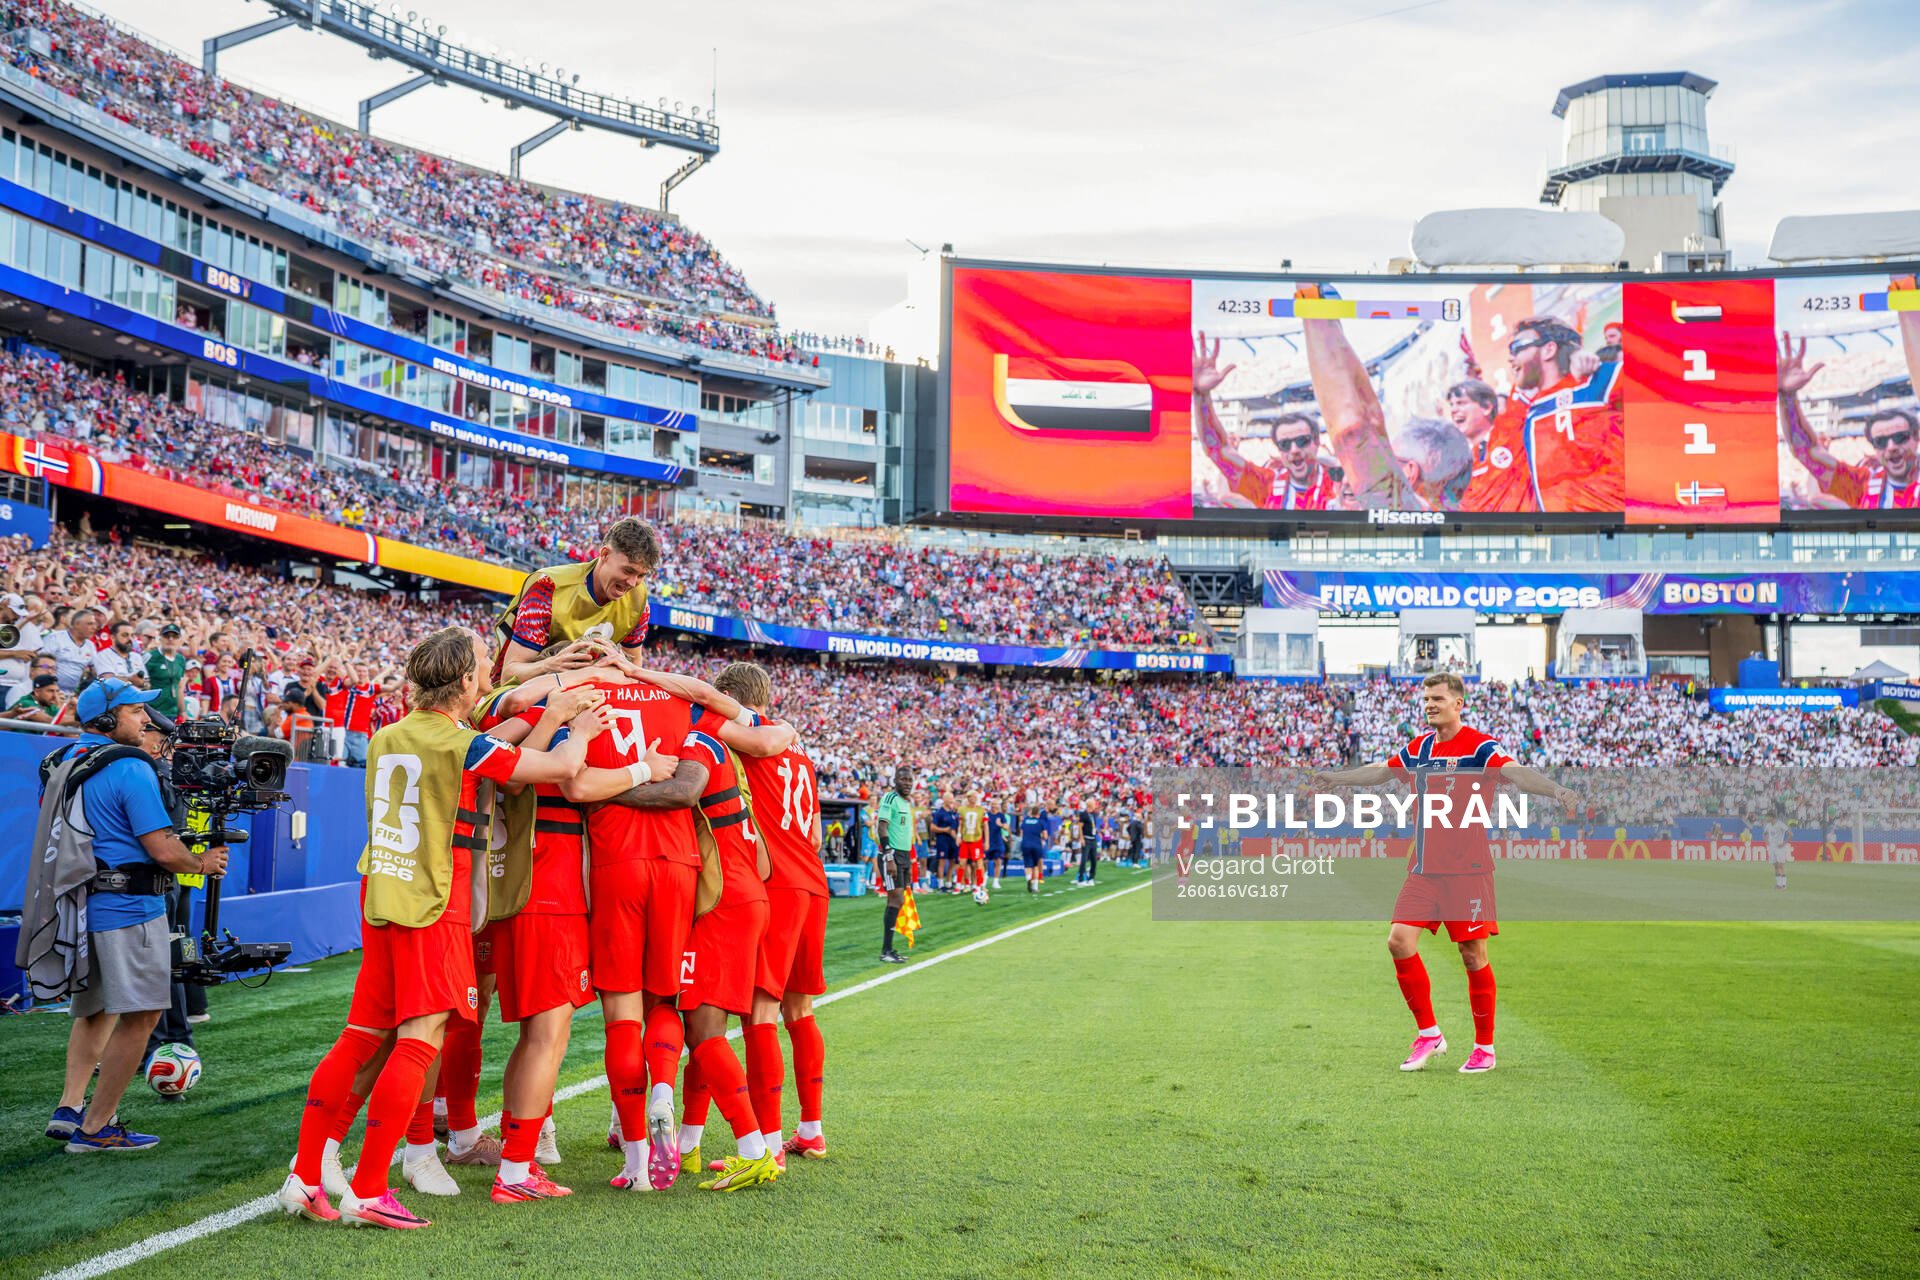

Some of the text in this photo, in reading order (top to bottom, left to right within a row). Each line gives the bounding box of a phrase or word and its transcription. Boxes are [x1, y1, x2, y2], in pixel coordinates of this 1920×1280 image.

[1217, 299, 1262, 315] 42:33
[1803, 296, 1851, 312] 42:33
[1683, 349, 1716, 381] 1
[1683, 423, 1716, 454] 1
[225, 502, 278, 532] NORWAY
[1368, 508, 1446, 525] Hisense
[1319, 585, 1601, 608] FIFA WORLD CUP 2026
[1663, 582, 1778, 604] BOSTON
[669, 609, 714, 632] BOSTON
[828, 636, 980, 662] FIFA WORLD CUP 2026
[1136, 653, 1205, 670] BOSTON
[617, 688, 671, 702] HAALAND
[1724, 695, 1747, 705] FIFA
[1748, 695, 1784, 705] WORLD
[1784, 695, 1806, 705] CUP
[606, 708, 648, 764] 9
[1445, 777, 1456, 795] 7
[777, 757, 814, 838] 10
[374, 827, 403, 844] FIFA
[1506, 839, 1566, 860] lovin'
[1570, 839, 1587, 860] it
[1671, 840, 1706, 861] i'm
[1711, 841, 1768, 862] lovin
[394, 856, 417, 867] CUP
[1470, 899, 1482, 922] 7
